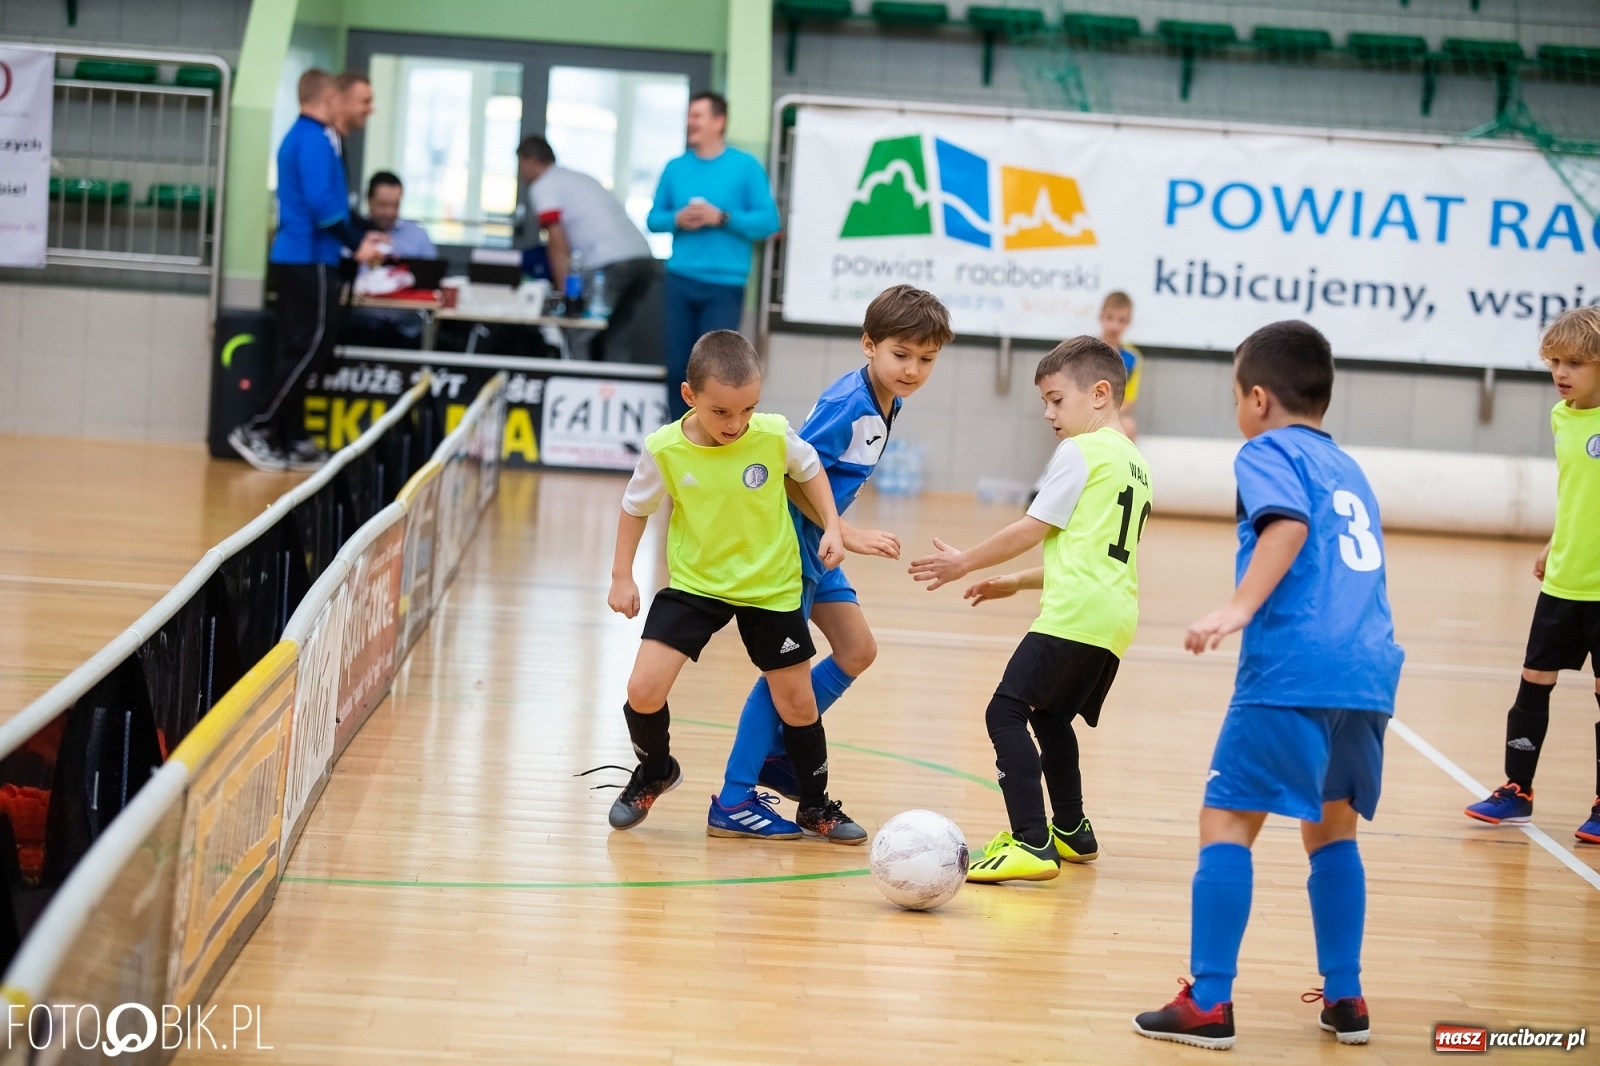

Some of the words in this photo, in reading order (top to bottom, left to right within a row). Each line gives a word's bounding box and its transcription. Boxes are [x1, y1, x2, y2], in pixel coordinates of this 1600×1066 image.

[1165, 178, 1465, 243] POWIAT
[1489, 197, 1600, 254] RA
[832, 251, 935, 282] powiat
[955, 256, 1101, 292] raciborski
[1154, 256, 1437, 321] kibicujemy,
[1468, 284, 1600, 330] wspi
[1332, 489, 1383, 572] 3
